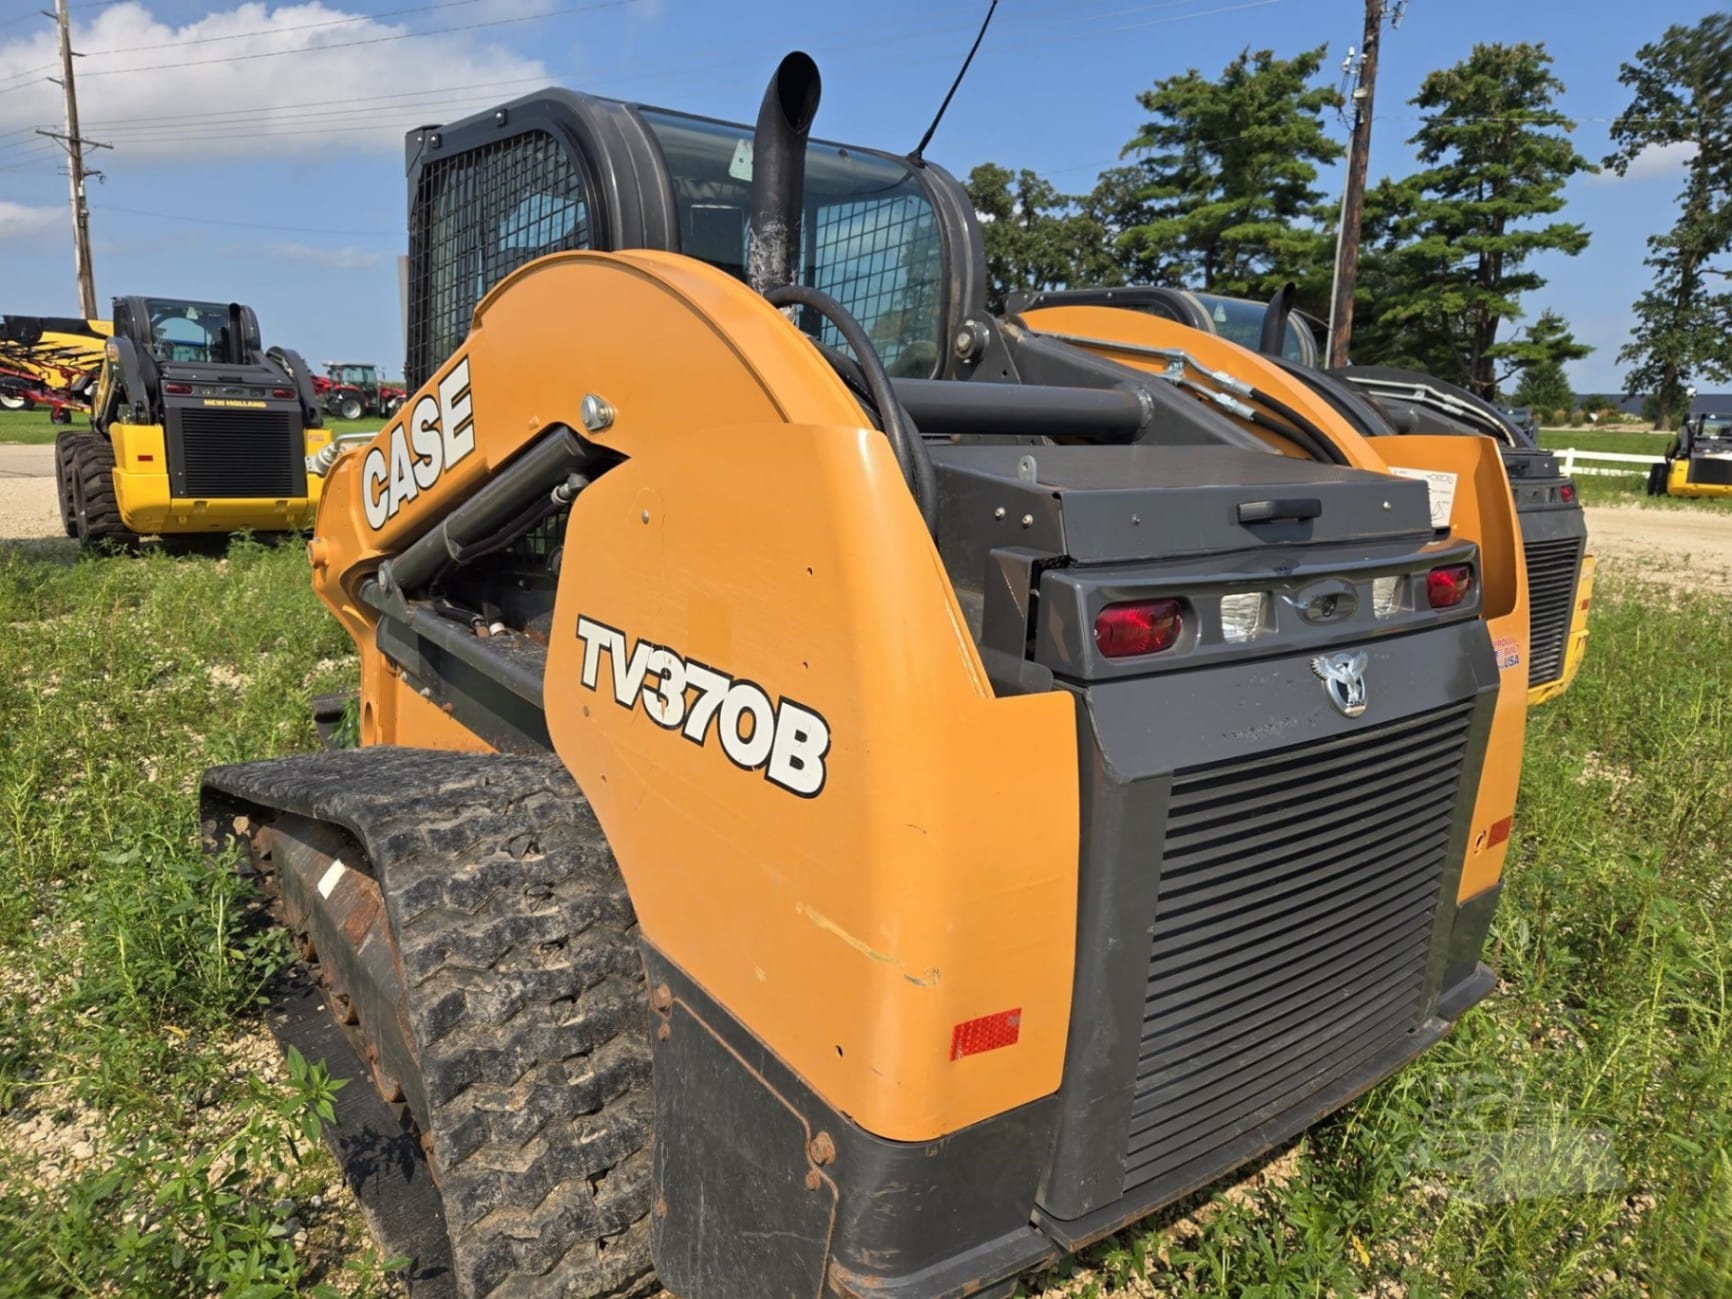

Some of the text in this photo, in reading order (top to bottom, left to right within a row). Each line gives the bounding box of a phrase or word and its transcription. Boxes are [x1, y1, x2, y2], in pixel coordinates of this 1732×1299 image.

[203, 399, 267, 408] NEW HOLLAND
[362, 355, 475, 531] CASE
[576, 614, 831, 798] TV370B
[1504, 655, 1520, 667] USA
